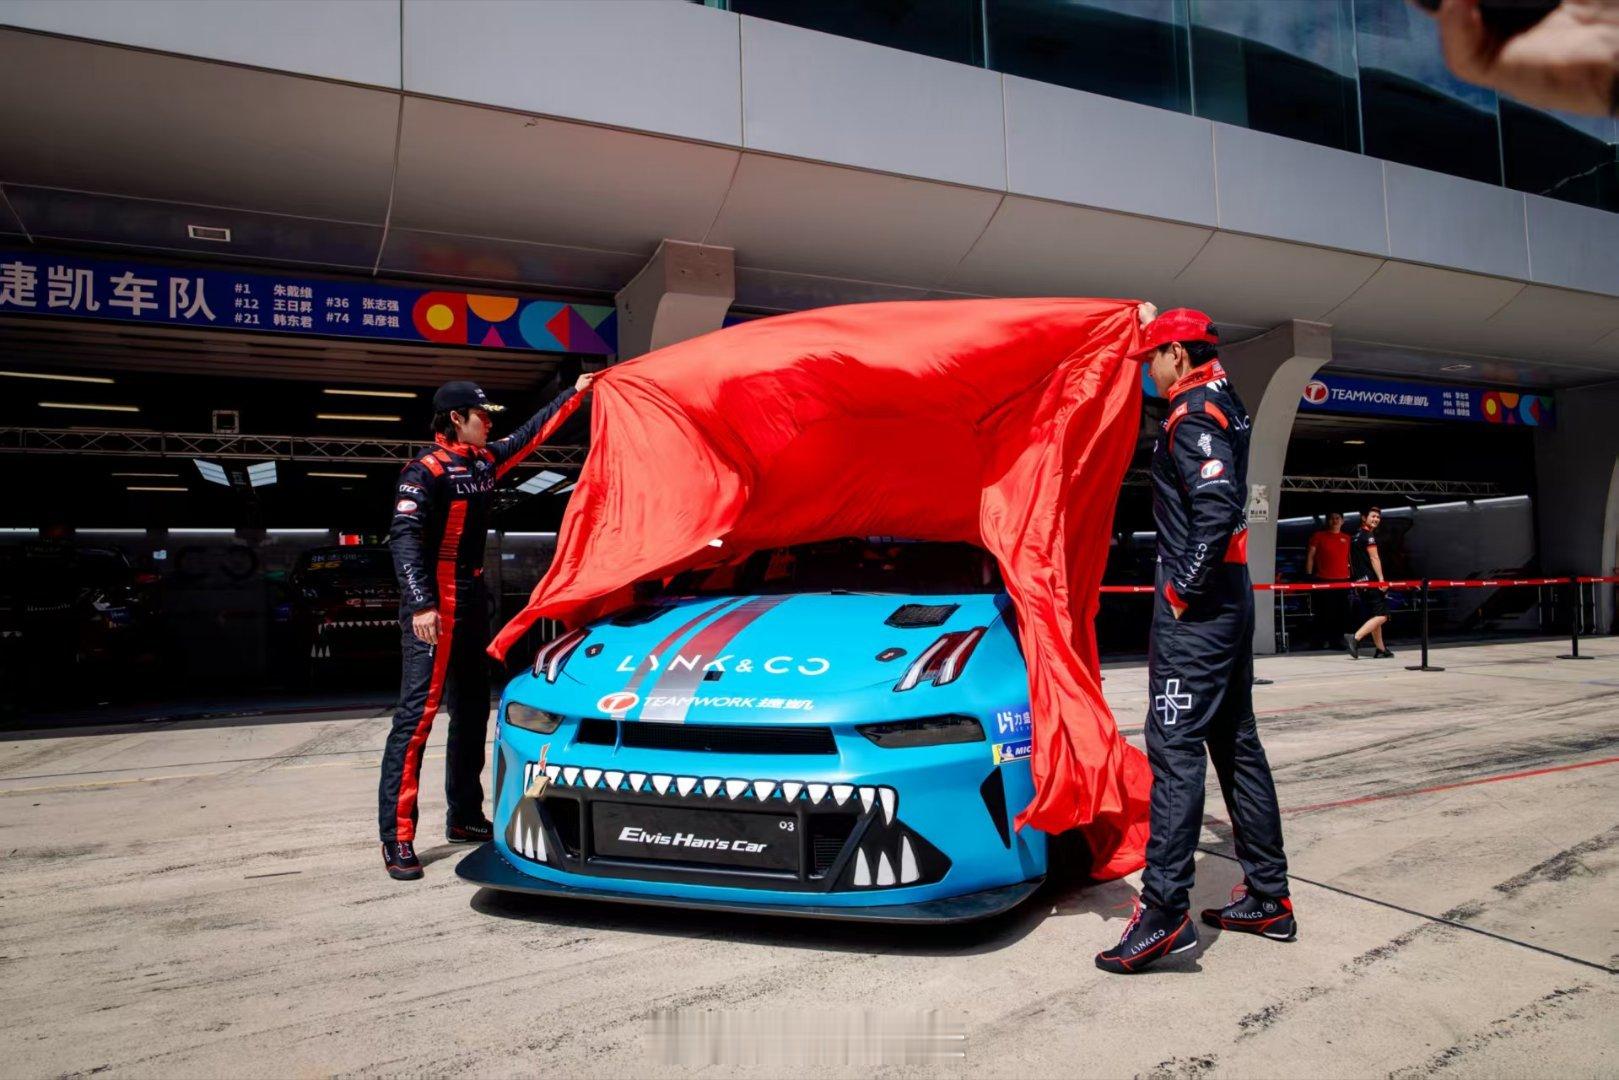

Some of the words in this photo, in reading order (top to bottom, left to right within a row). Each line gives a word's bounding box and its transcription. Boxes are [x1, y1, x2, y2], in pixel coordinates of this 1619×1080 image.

[0, 261, 216, 321] 捷凯车队
[235, 283, 251, 294] #1
[234, 298, 259, 309] #12
[326, 297, 349, 308] #36
[234, 313, 260, 325] #21
[326, 312, 350, 323] #74
[1331, 388, 1398, 405] TEAMWORK
[643, 696, 755, 708] TEAMWORK
[1015, 745, 1032, 755] MIC
[618, 826, 671, 845] Elvis
[672, 833, 729, 850] Han's
[731, 840, 767, 853] Car
